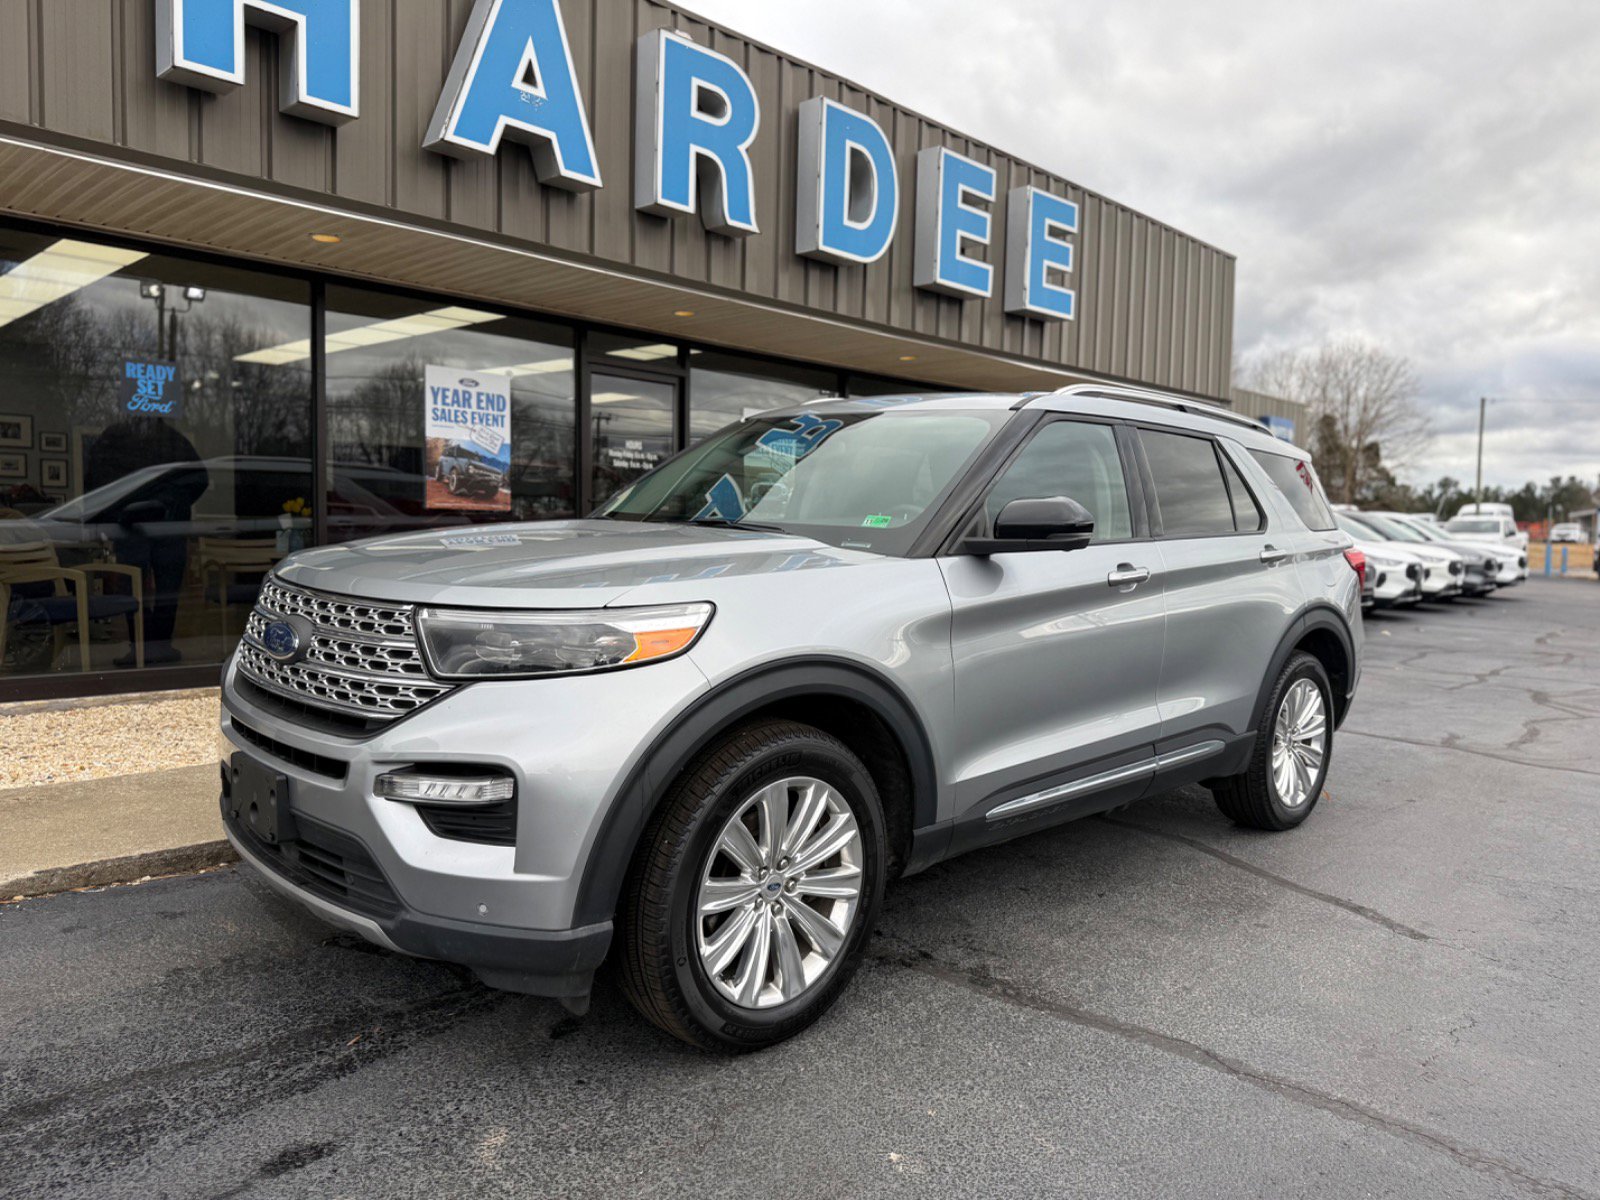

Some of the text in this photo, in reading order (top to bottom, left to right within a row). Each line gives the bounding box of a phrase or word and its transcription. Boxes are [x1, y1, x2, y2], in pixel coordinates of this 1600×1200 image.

[125, 361, 176, 381] READY
[137, 380, 164, 396] SET
[127, 393, 176, 413] Ford
[430, 386, 506, 412] YEAR END
[432, 407, 505, 428] SALES EVENT
